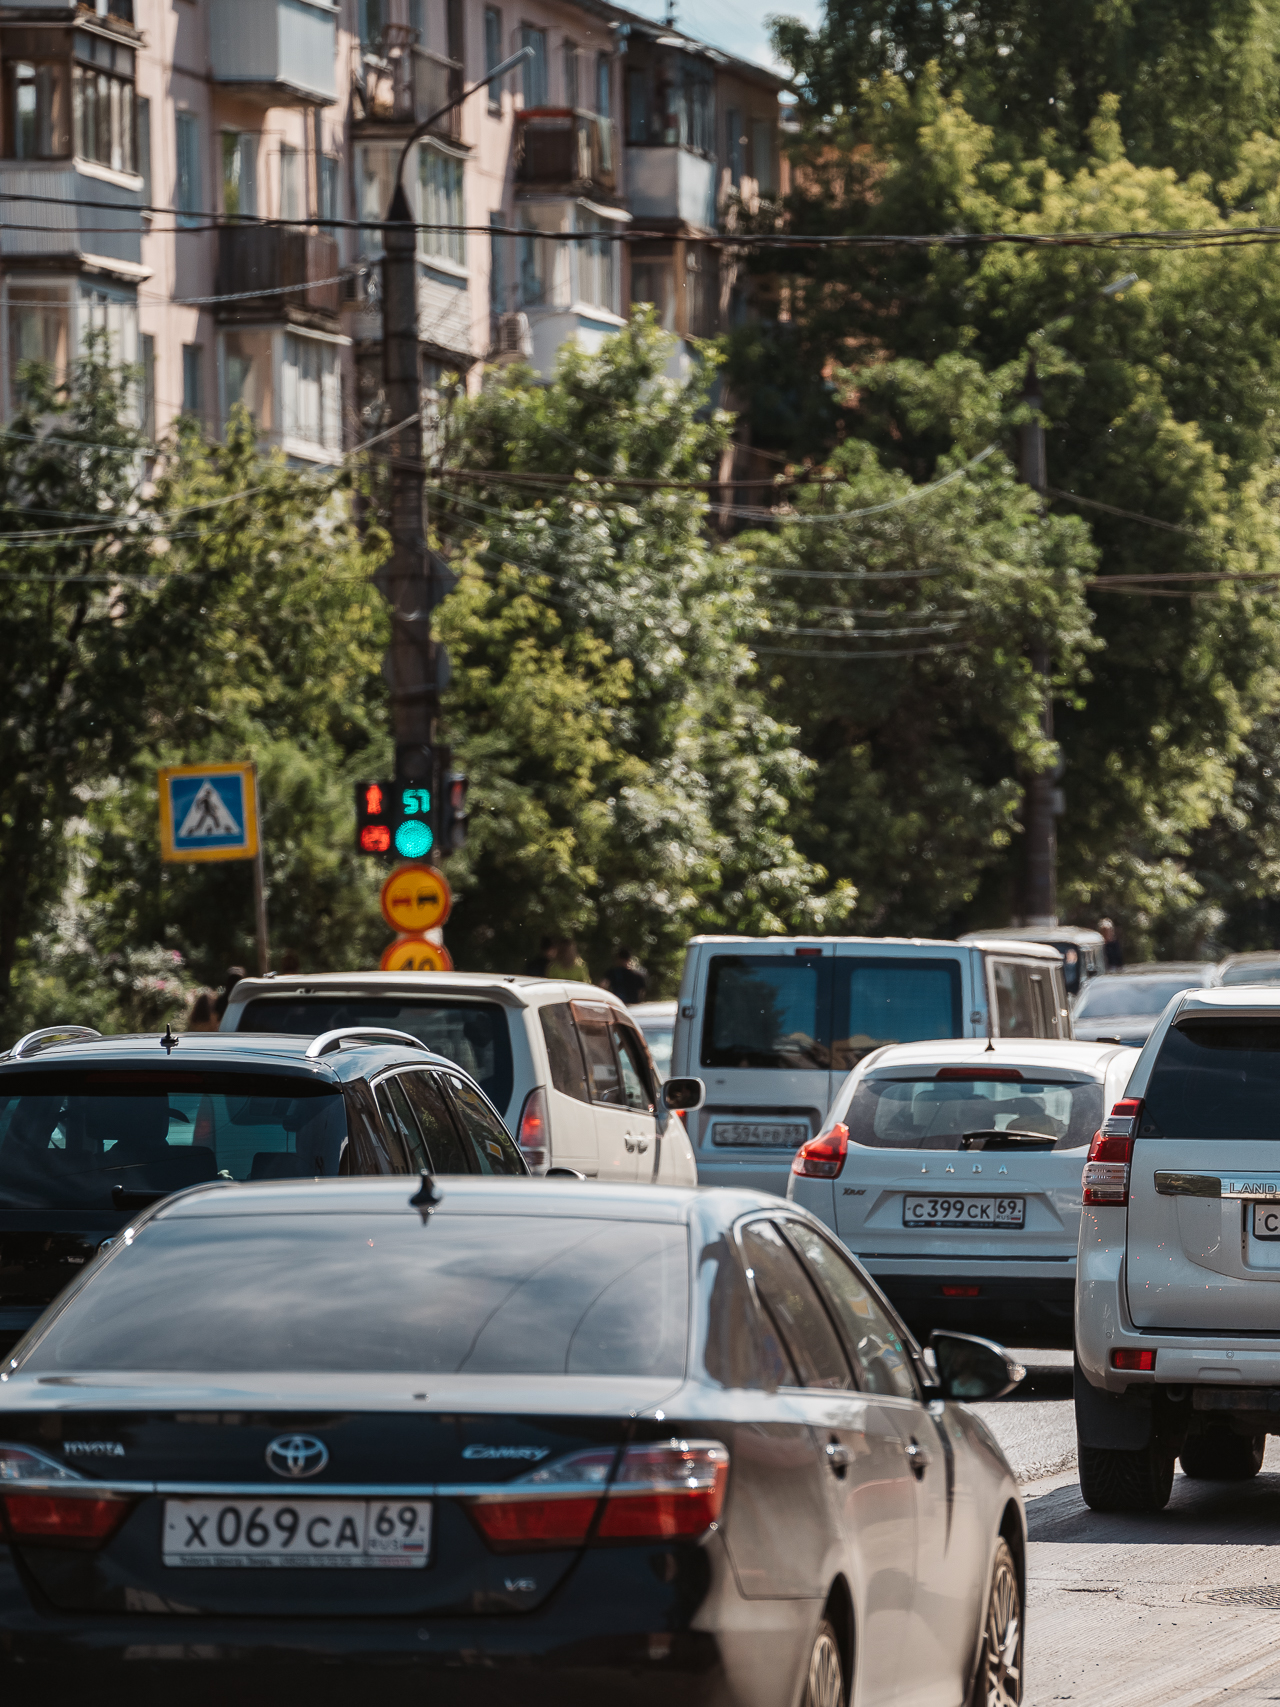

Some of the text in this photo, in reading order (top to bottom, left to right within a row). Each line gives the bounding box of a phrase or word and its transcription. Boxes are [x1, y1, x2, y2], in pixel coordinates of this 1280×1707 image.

[402, 788, 431, 815] 57
[920, 1163, 1008, 1175] LADA
[1229, 1183, 1277, 1195] LAND
[912, 1200, 1018, 1220] С399СК 69
[63, 1441, 126, 1457] TOYOTA
[184, 1505, 418, 1549] Х069СА 69
